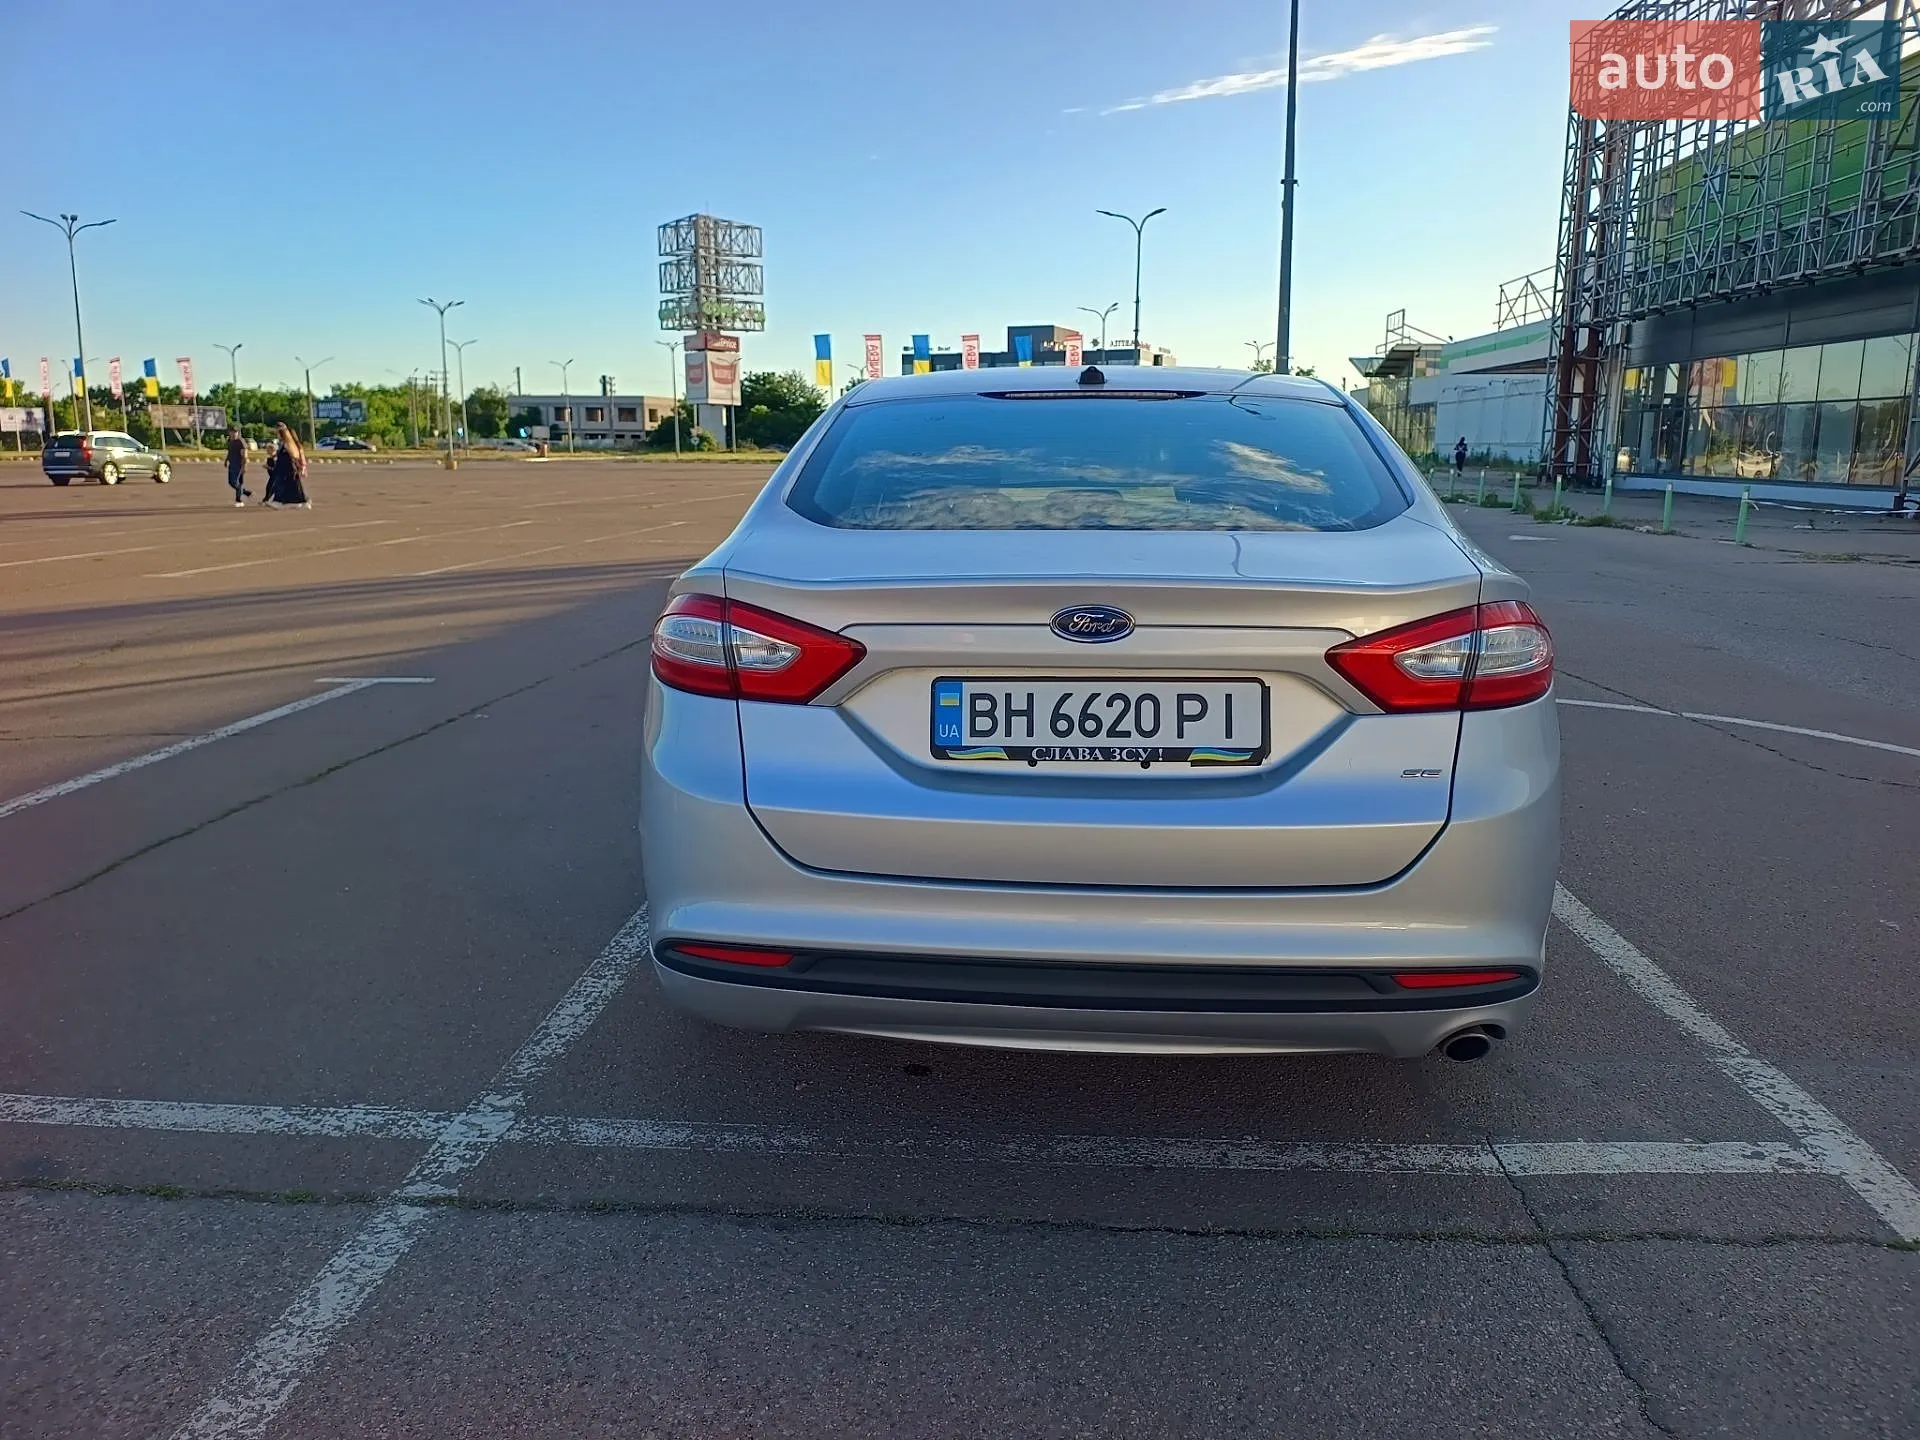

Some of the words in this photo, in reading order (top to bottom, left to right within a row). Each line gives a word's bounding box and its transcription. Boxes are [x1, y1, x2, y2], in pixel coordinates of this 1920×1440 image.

[1069, 612, 1116, 633] Ford
[969, 692, 1035, 739] BH
[1049, 692, 1161, 739] 6620
[938, 723, 960, 739] UA
[1031, 747, 1102, 762] СЛАВА
